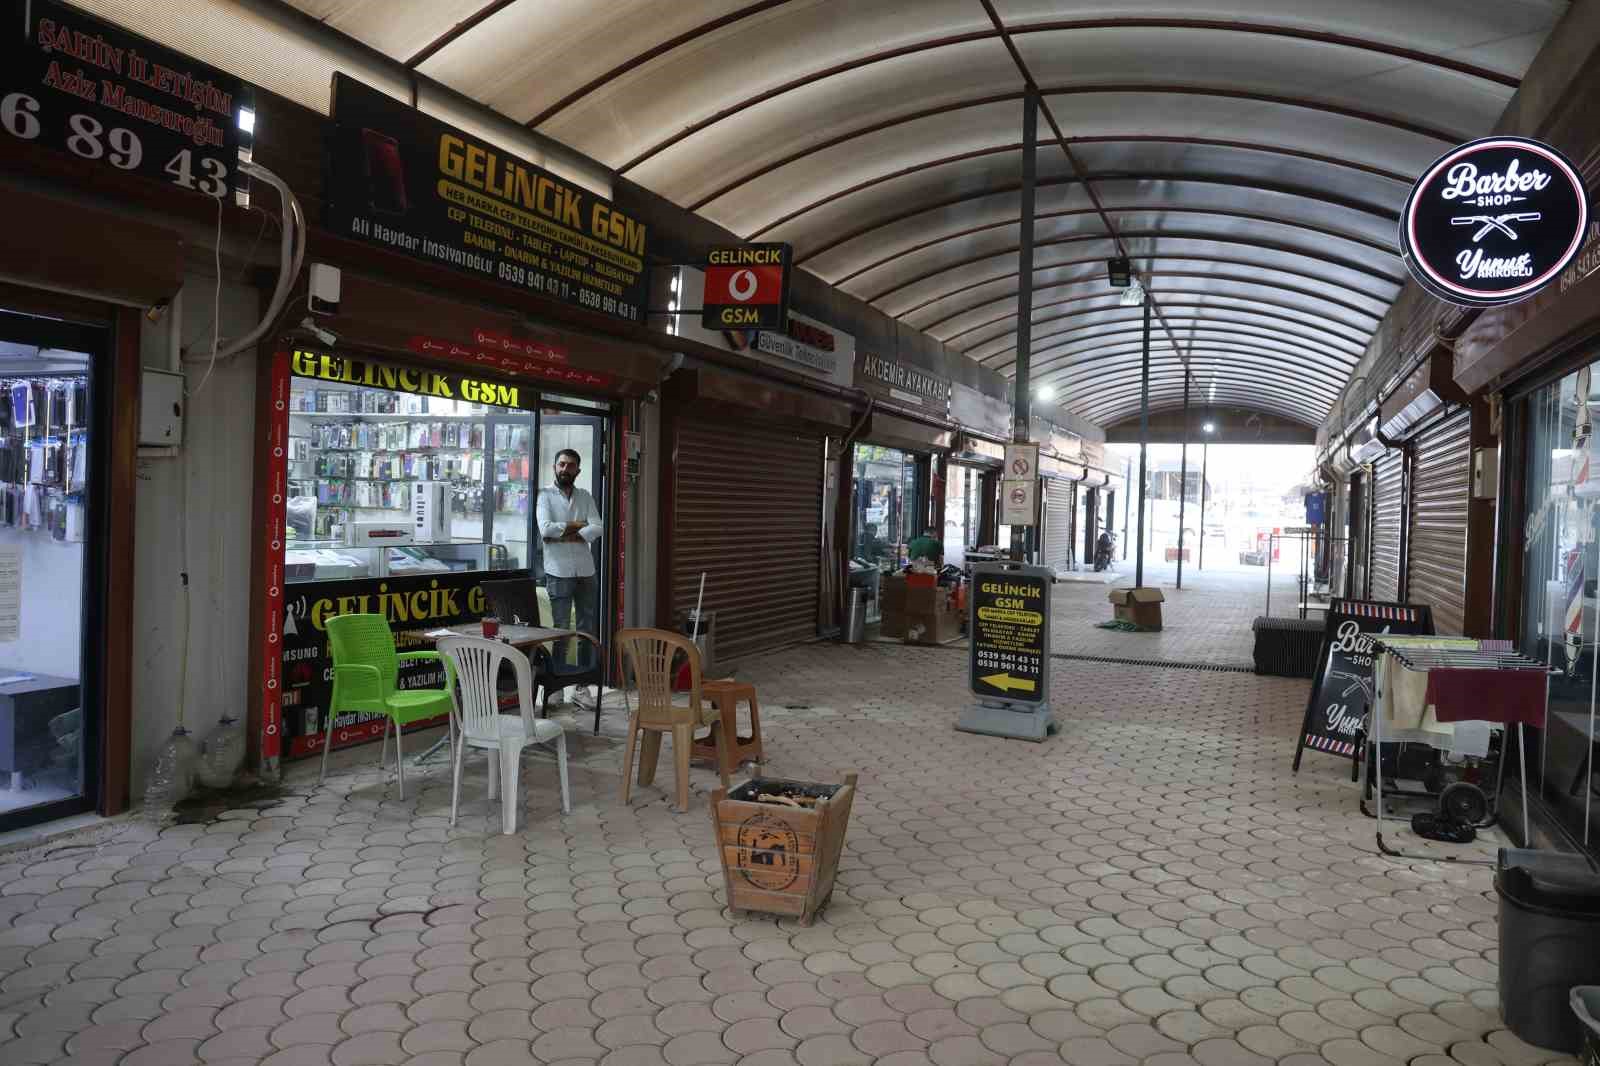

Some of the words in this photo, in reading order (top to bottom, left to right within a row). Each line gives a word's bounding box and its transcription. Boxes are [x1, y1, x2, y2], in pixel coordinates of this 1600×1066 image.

[0, 92, 41, 139] 6
[66, 113, 143, 170] 89
[164, 148, 228, 198] 43
[1441, 158, 1551, 200] Barber
[1477, 195, 1512, 207] SHOP
[591, 200, 647, 256] GSM
[351, 215, 371, 237] Ali
[373, 222, 421, 252] Haydar
[498, 261, 525, 285] 0539
[527, 268, 545, 292] 941
[1456, 248, 1532, 280] Yunus
[721, 307, 760, 324] GSM
[459, 377, 521, 408] GSM
[995, 598, 1025, 609] GSM
[978, 651, 999, 660] 0539
[1017, 656, 1028, 664] 43
[1030, 657, 1040, 665] 11
[1017, 664, 1028, 672] 43
[1030, 665, 1040, 674] 11
[1353, 655, 1373, 666] SHO
